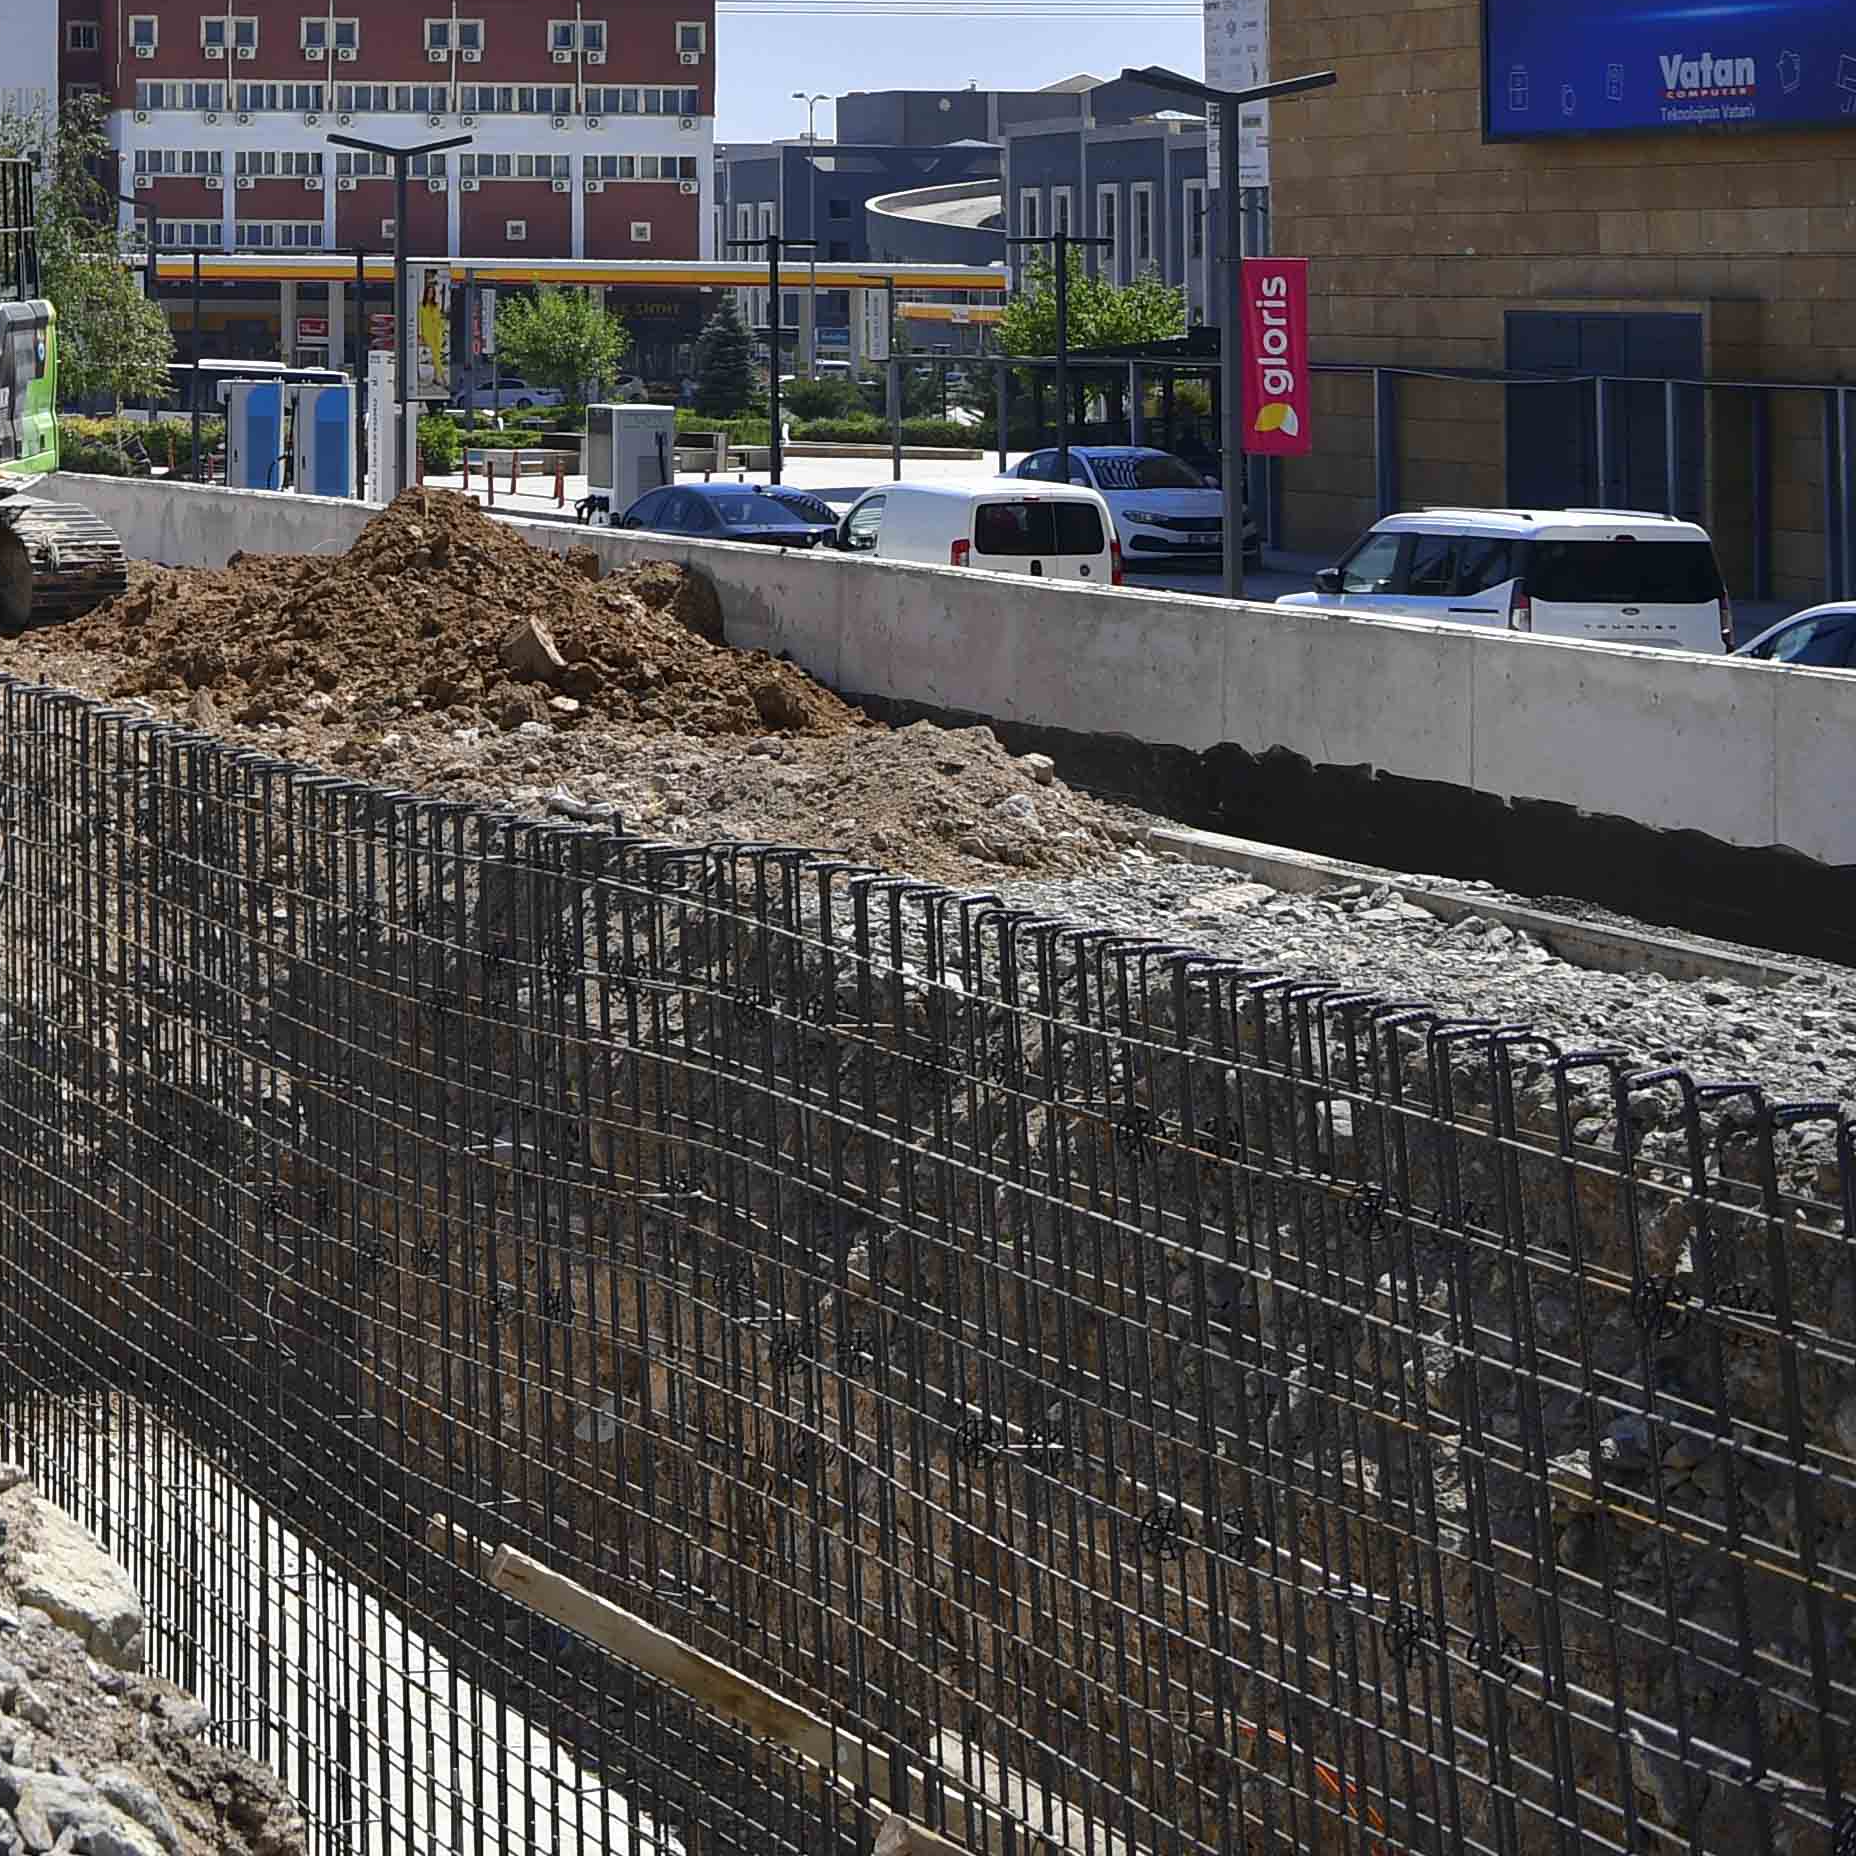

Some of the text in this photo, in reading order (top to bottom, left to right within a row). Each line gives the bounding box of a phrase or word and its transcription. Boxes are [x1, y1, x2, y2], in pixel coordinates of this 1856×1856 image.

[1658, 52, 1756, 90] Vatan
[1665, 88, 1747, 99] COMPUTER
[1255, 276, 1295, 396] gloris
